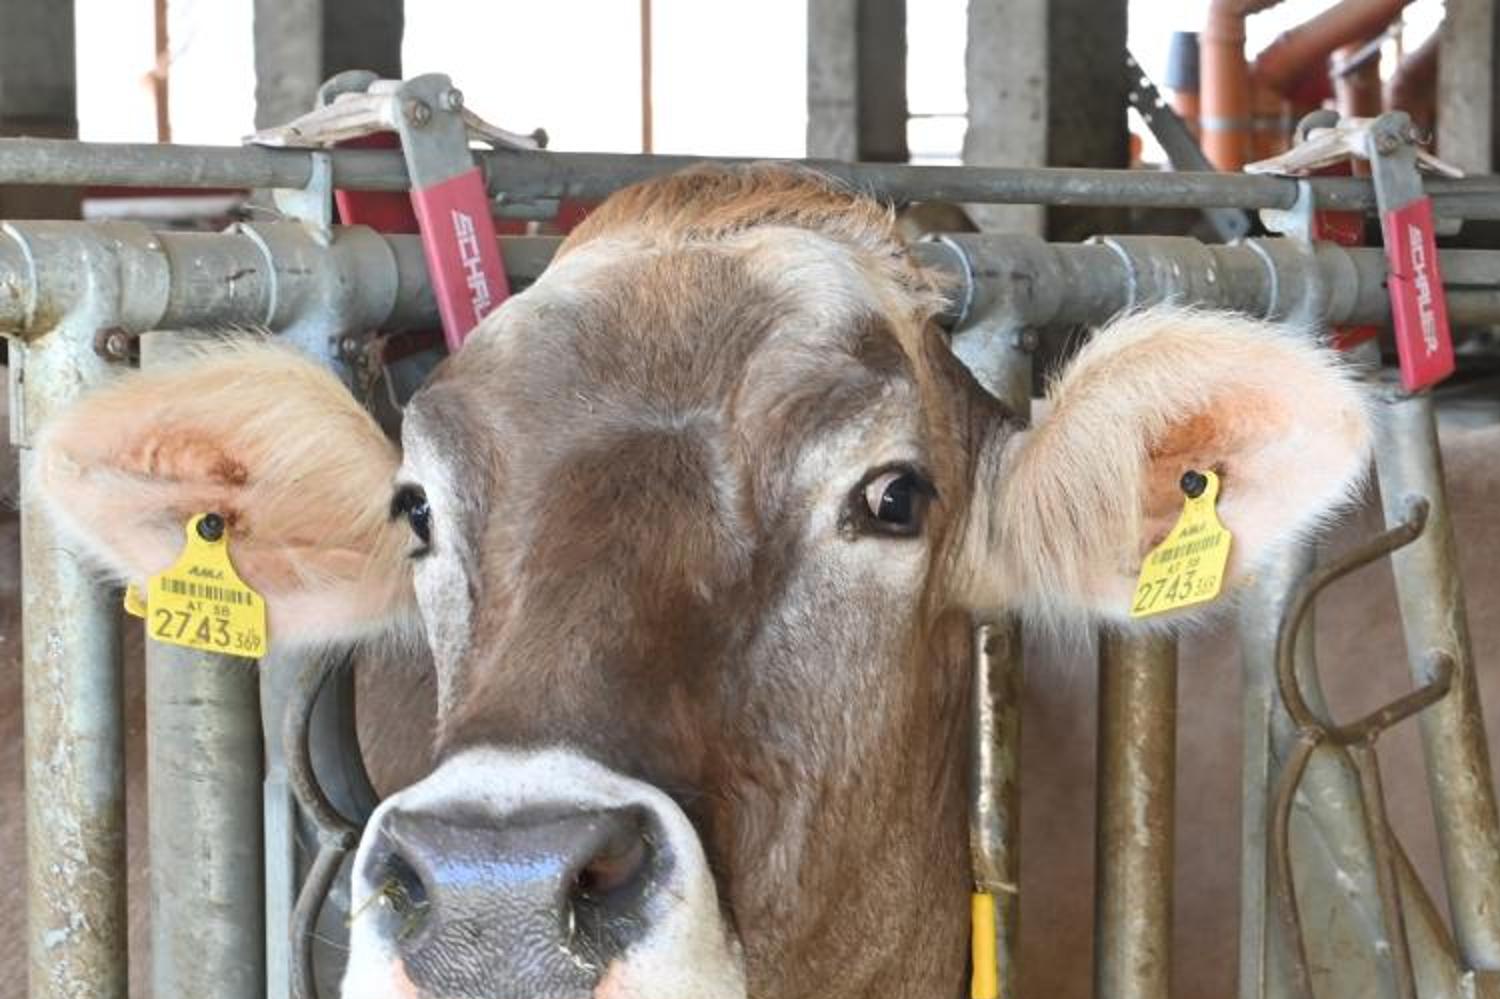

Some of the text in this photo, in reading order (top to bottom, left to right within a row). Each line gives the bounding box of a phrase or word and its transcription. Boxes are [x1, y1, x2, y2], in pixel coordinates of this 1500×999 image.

[1408, 224, 1439, 357] SCHAUER
[1134, 570, 1198, 612] 2743
[155, 608, 231, 646] 2743
